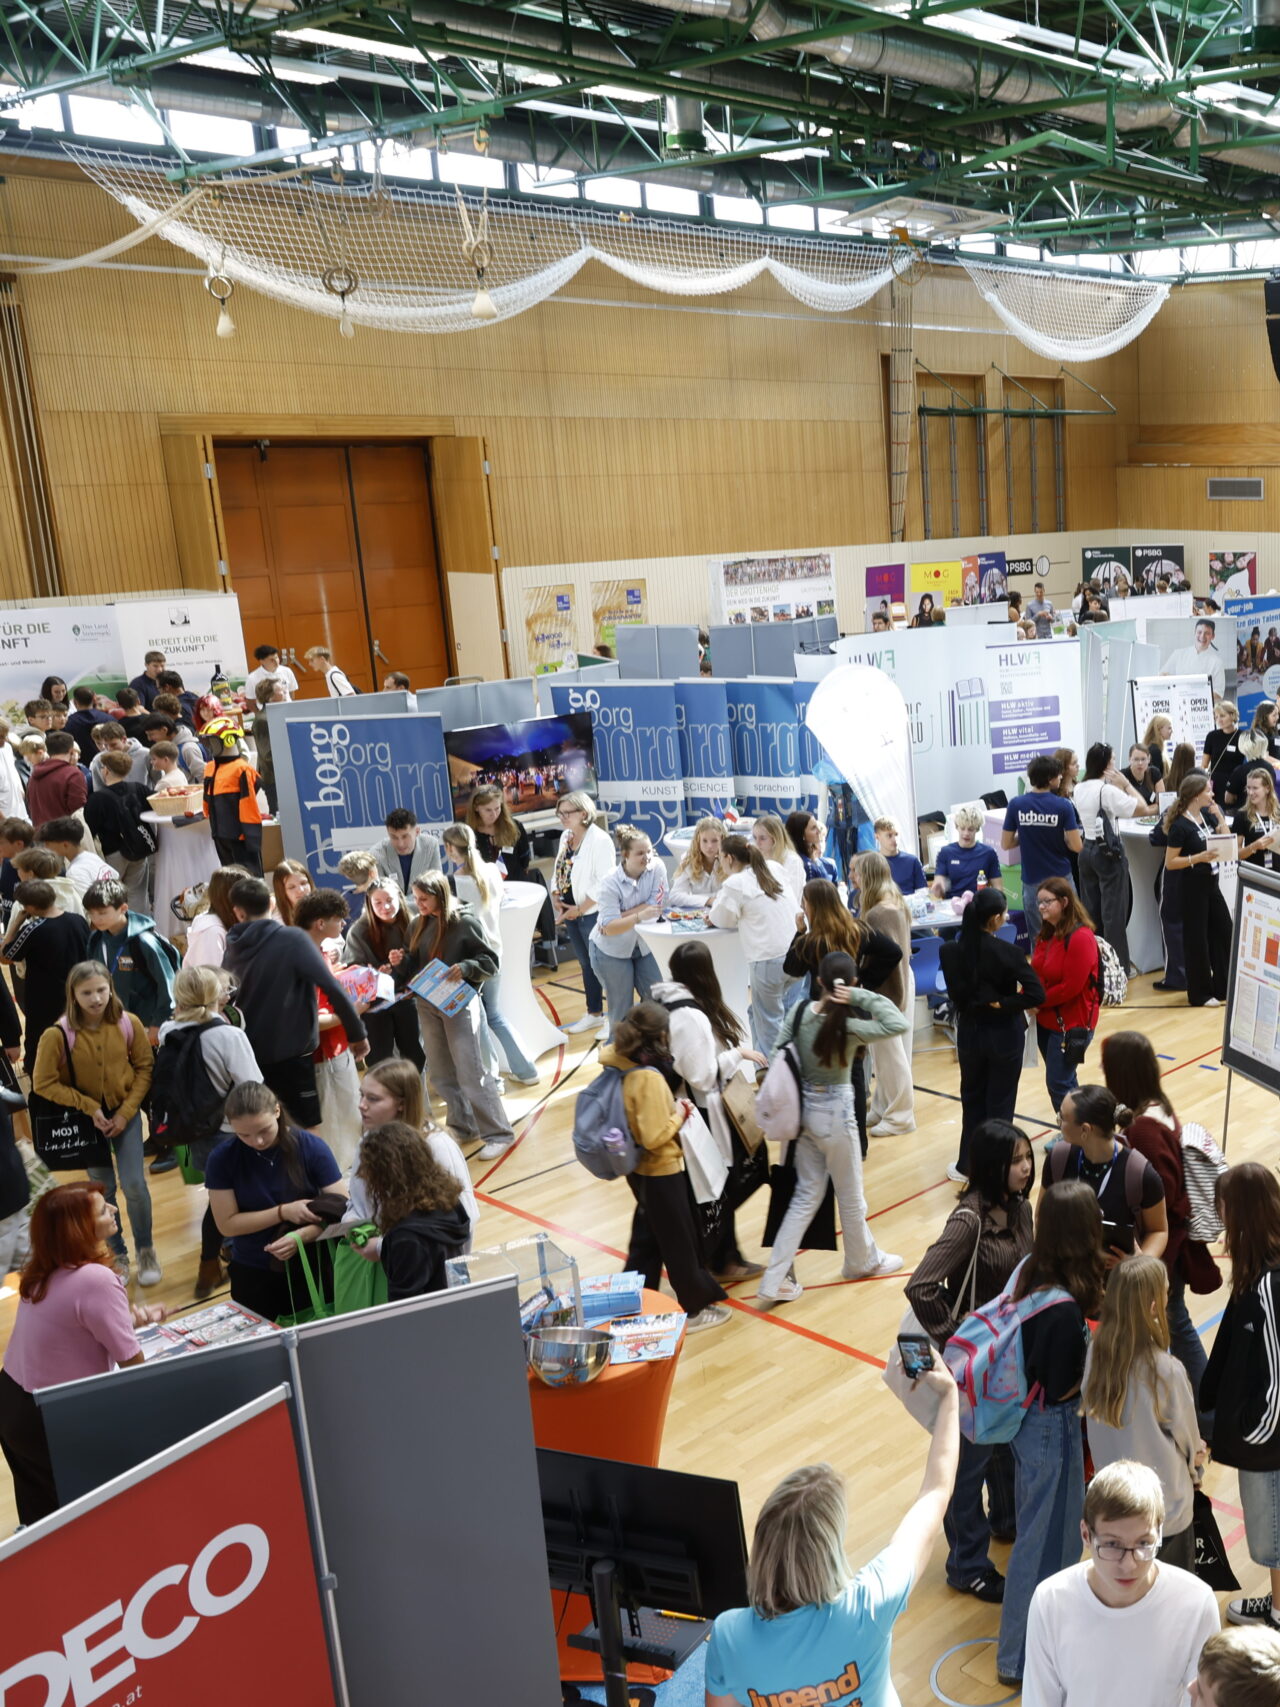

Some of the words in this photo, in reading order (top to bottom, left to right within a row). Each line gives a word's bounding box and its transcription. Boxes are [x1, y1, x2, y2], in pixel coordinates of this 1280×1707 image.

[1010, 561, 1032, 573] PSBG
[1227, 601, 1254, 615] your-job
[1262, 612, 1280, 625] Talent
[0, 620, 23, 636] ÜR
[27, 621, 51, 635] DIE
[148, 635, 182, 648] BEREIT
[183, 633, 202, 645] FÜR
[203, 634, 219, 643] DIE
[163, 644, 206, 655] ZUKUNFT
[1001, 701, 1016, 710] HLW
[1017, 699, 1035, 708] aktiv
[1152, 699, 1170, 708] OPEN
[1190, 698, 1208, 706] OPEN
[1002, 727, 1018, 736] HLW
[1019, 725, 1034, 734] vital
[1004, 752, 1019, 762] HLW
[304, 723, 350, 811] borg
[641, 785, 678, 796] KUNST
[683, 782, 729, 793] SCIENCE
[753, 782, 795, 794] sprachen
[44, 1135, 89, 1151] inside
